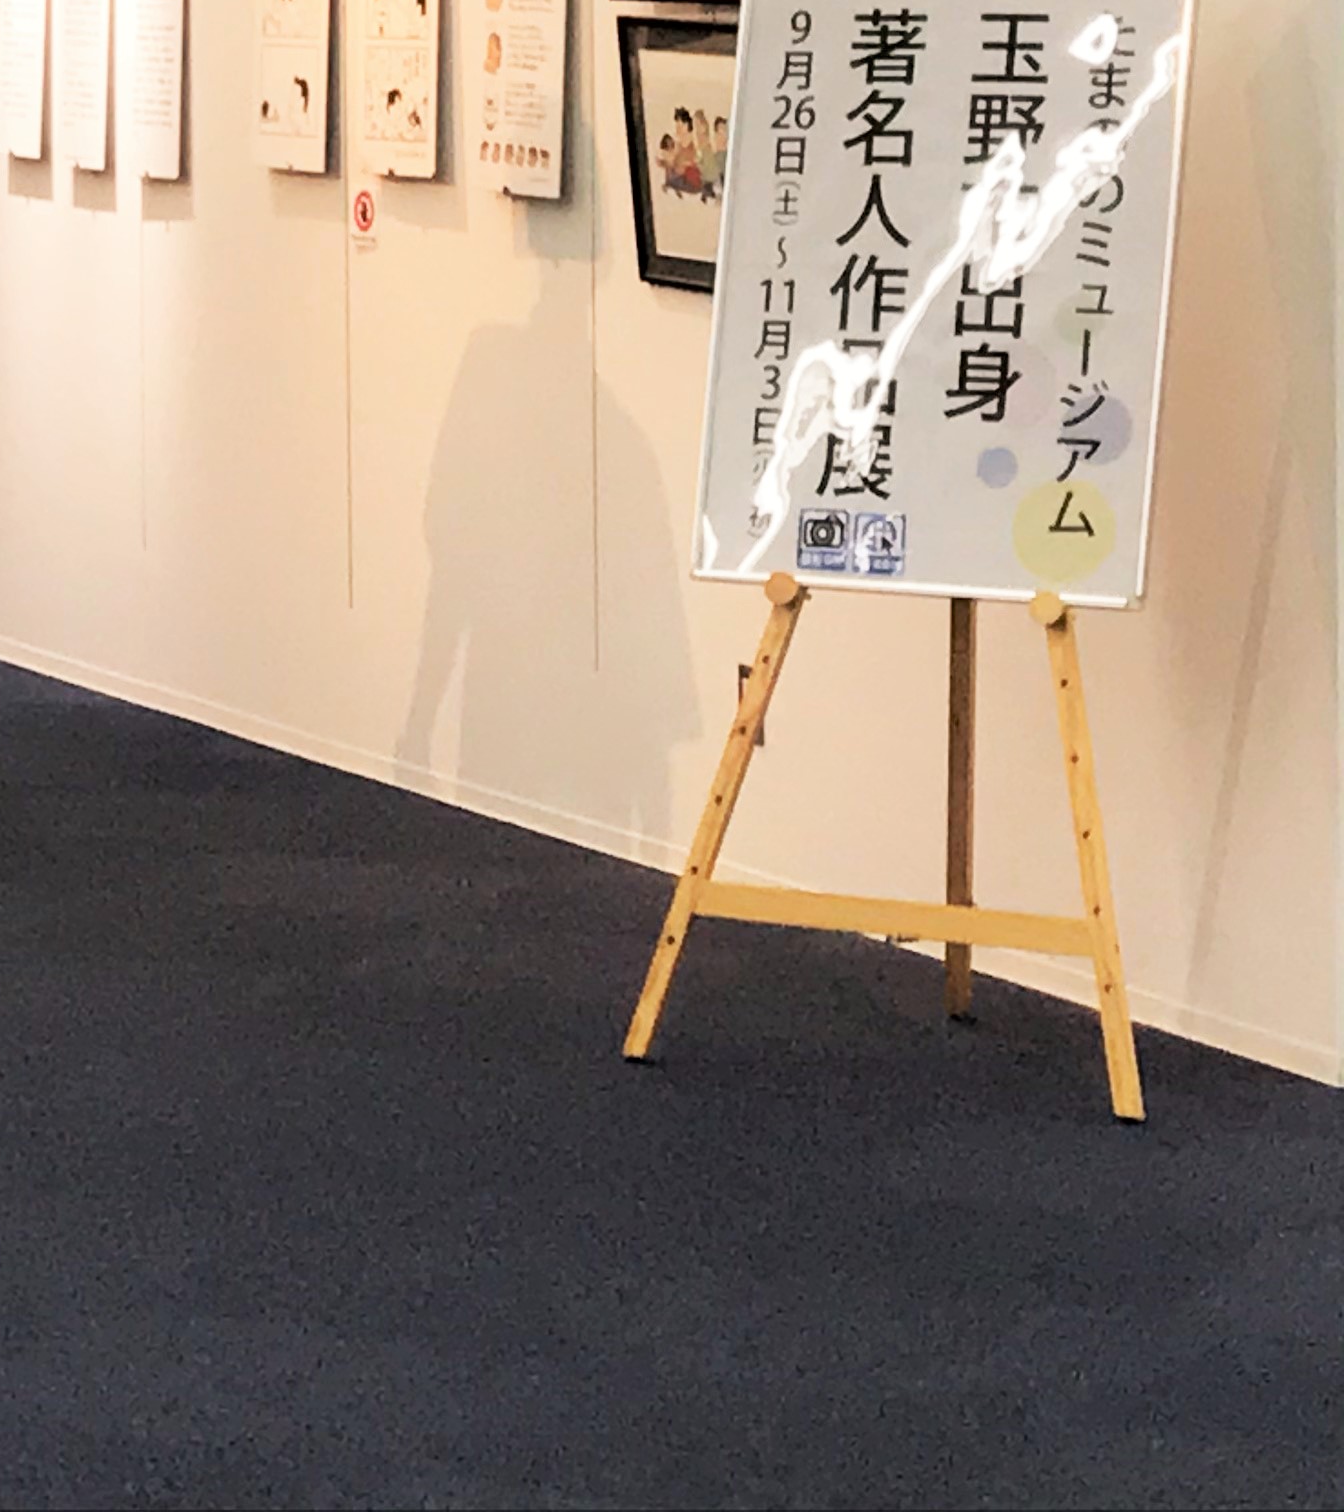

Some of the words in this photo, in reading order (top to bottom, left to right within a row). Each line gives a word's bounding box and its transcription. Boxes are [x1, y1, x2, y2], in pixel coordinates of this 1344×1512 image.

[944, 13, 1050, 423] 玉野出身
[1048, 12, 1136, 536] まのミュージアム
